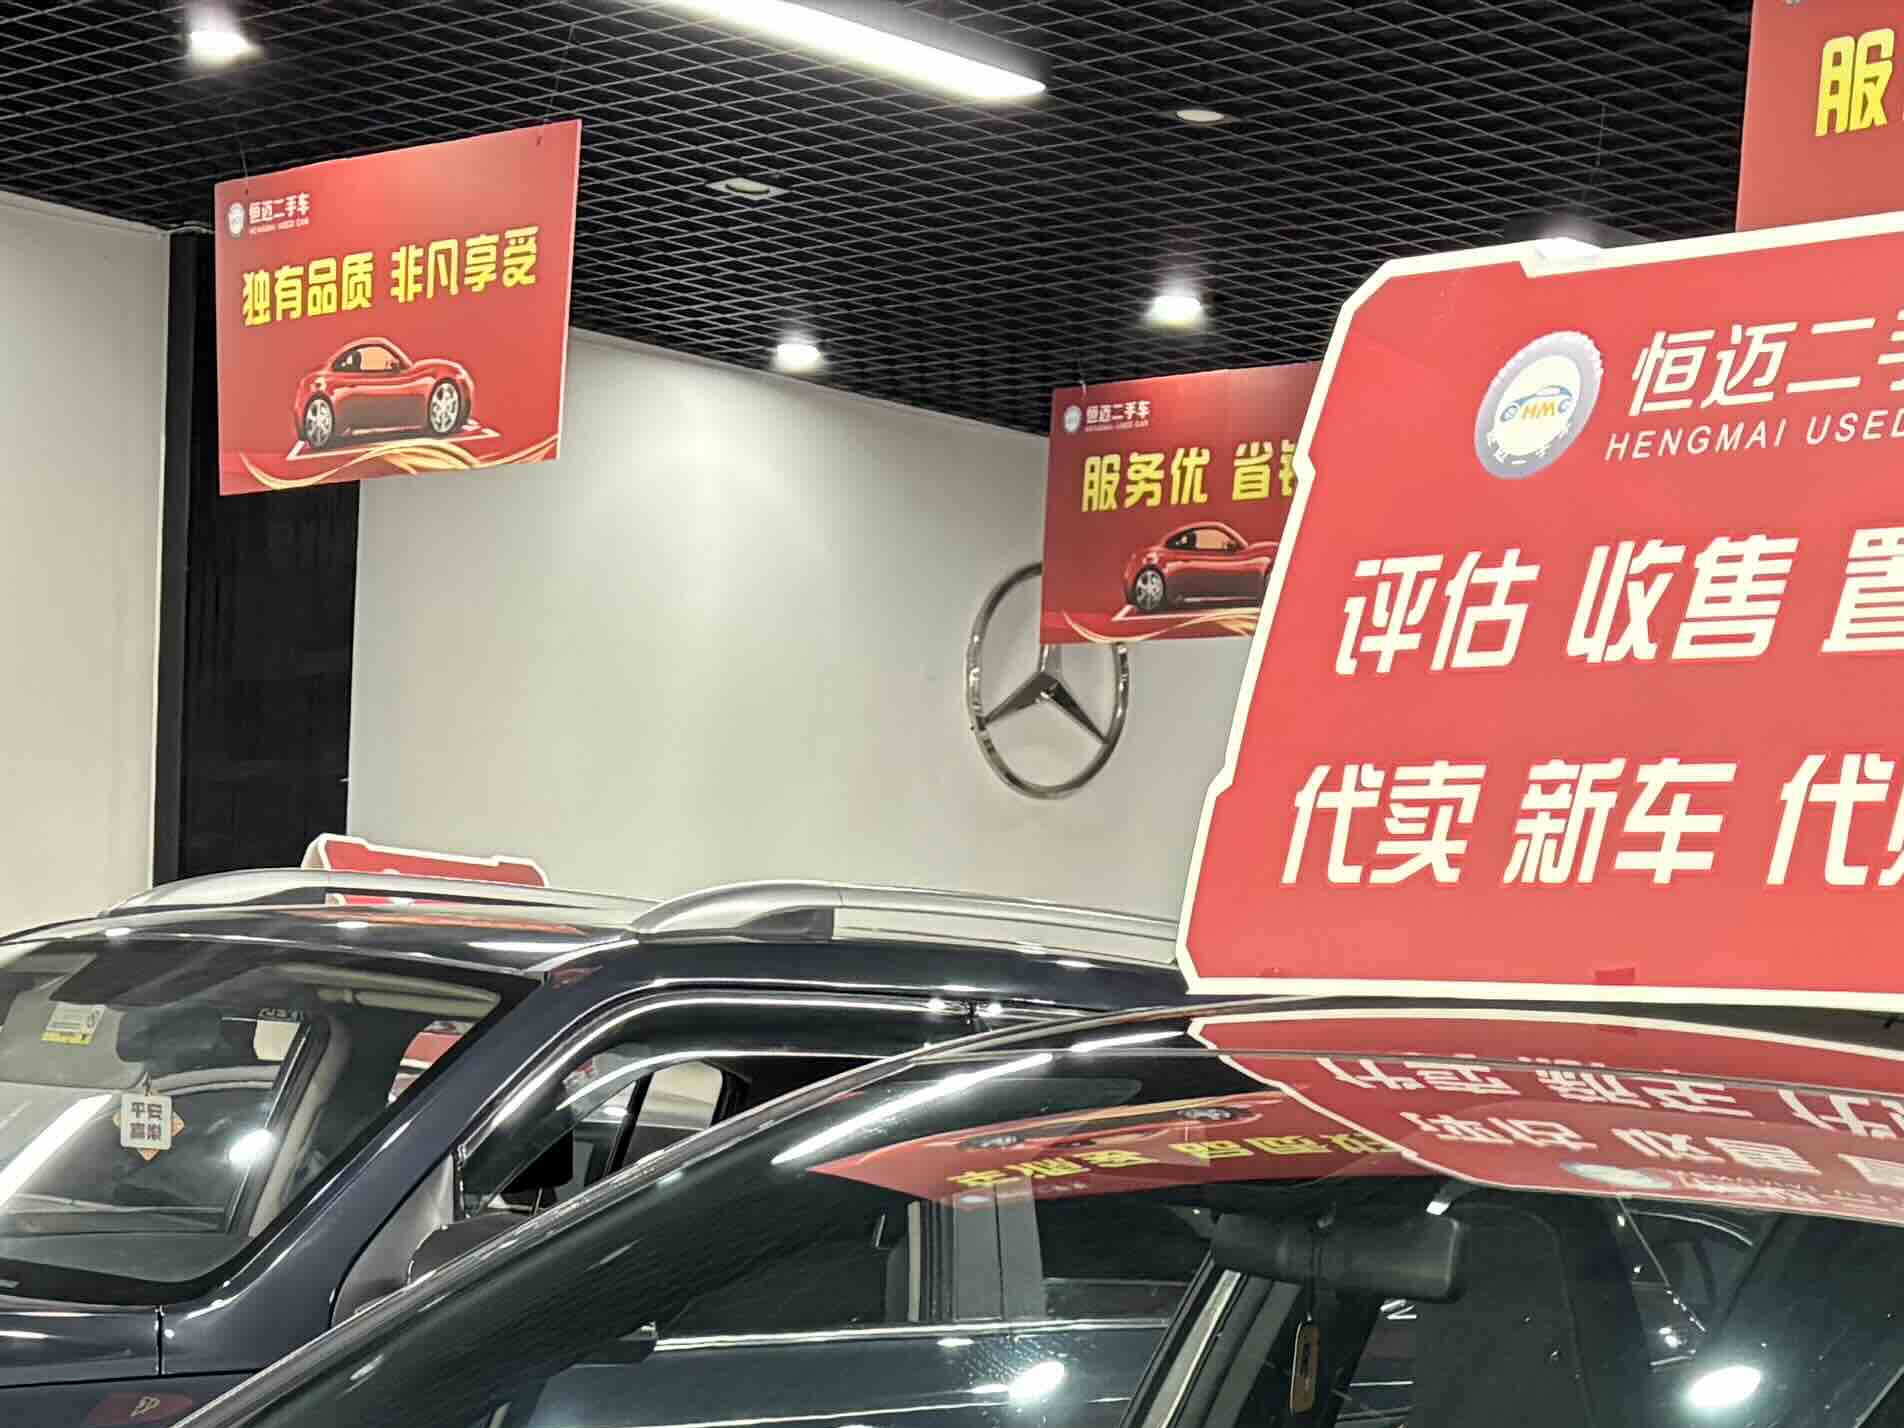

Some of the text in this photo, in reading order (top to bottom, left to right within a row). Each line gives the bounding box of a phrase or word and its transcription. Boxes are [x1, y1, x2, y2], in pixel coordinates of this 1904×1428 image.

[242, 225, 539, 327] 独有品质 非凡享受
[1081, 447, 1211, 513] 服务优
[1604, 421, 1786, 461] HENGMAI
[1335, 549, 1539, 676] 评估
[1565, 535, 1799, 664] 收售
[1281, 758, 1485, 886] 代卖
[1502, 757, 1735, 884] 新车
